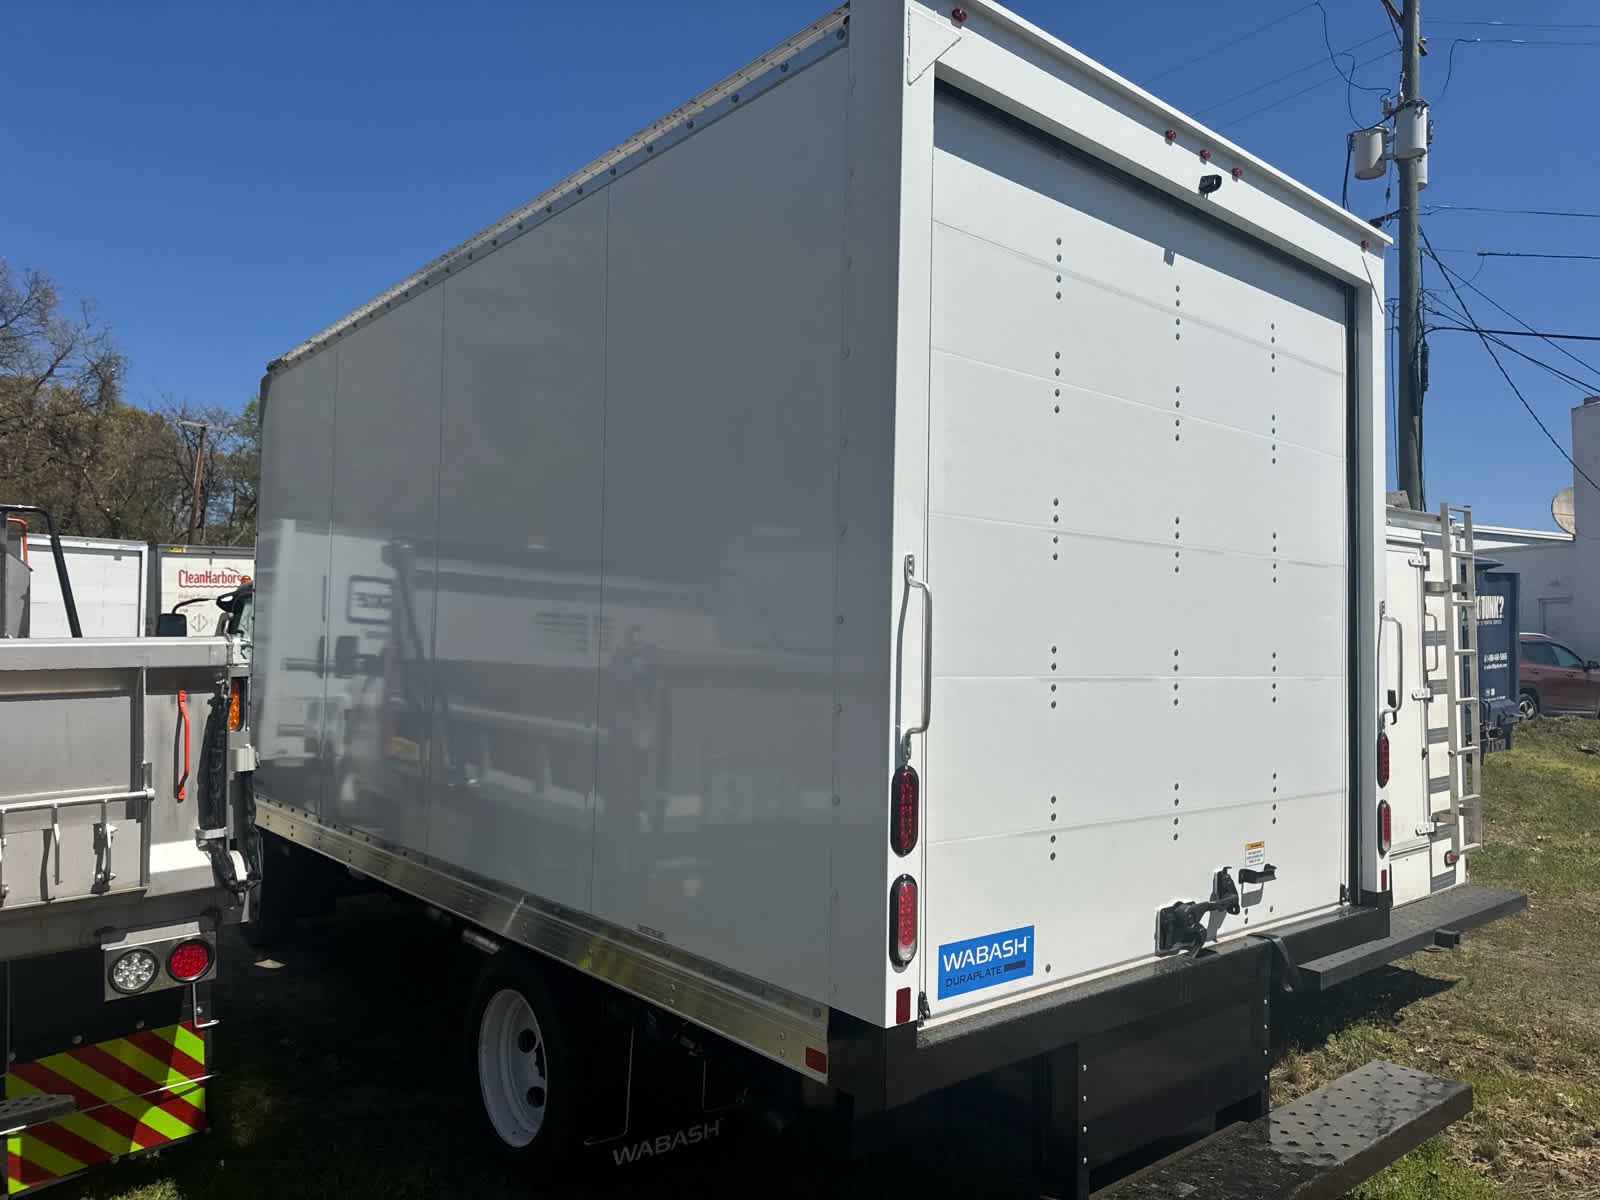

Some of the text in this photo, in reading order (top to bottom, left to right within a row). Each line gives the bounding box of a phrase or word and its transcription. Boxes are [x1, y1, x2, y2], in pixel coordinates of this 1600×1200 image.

[943, 936, 1027, 972] WABASH
[945, 965, 1002, 988] DURAPLATE
[612, 1119, 720, 1167] WABASH
